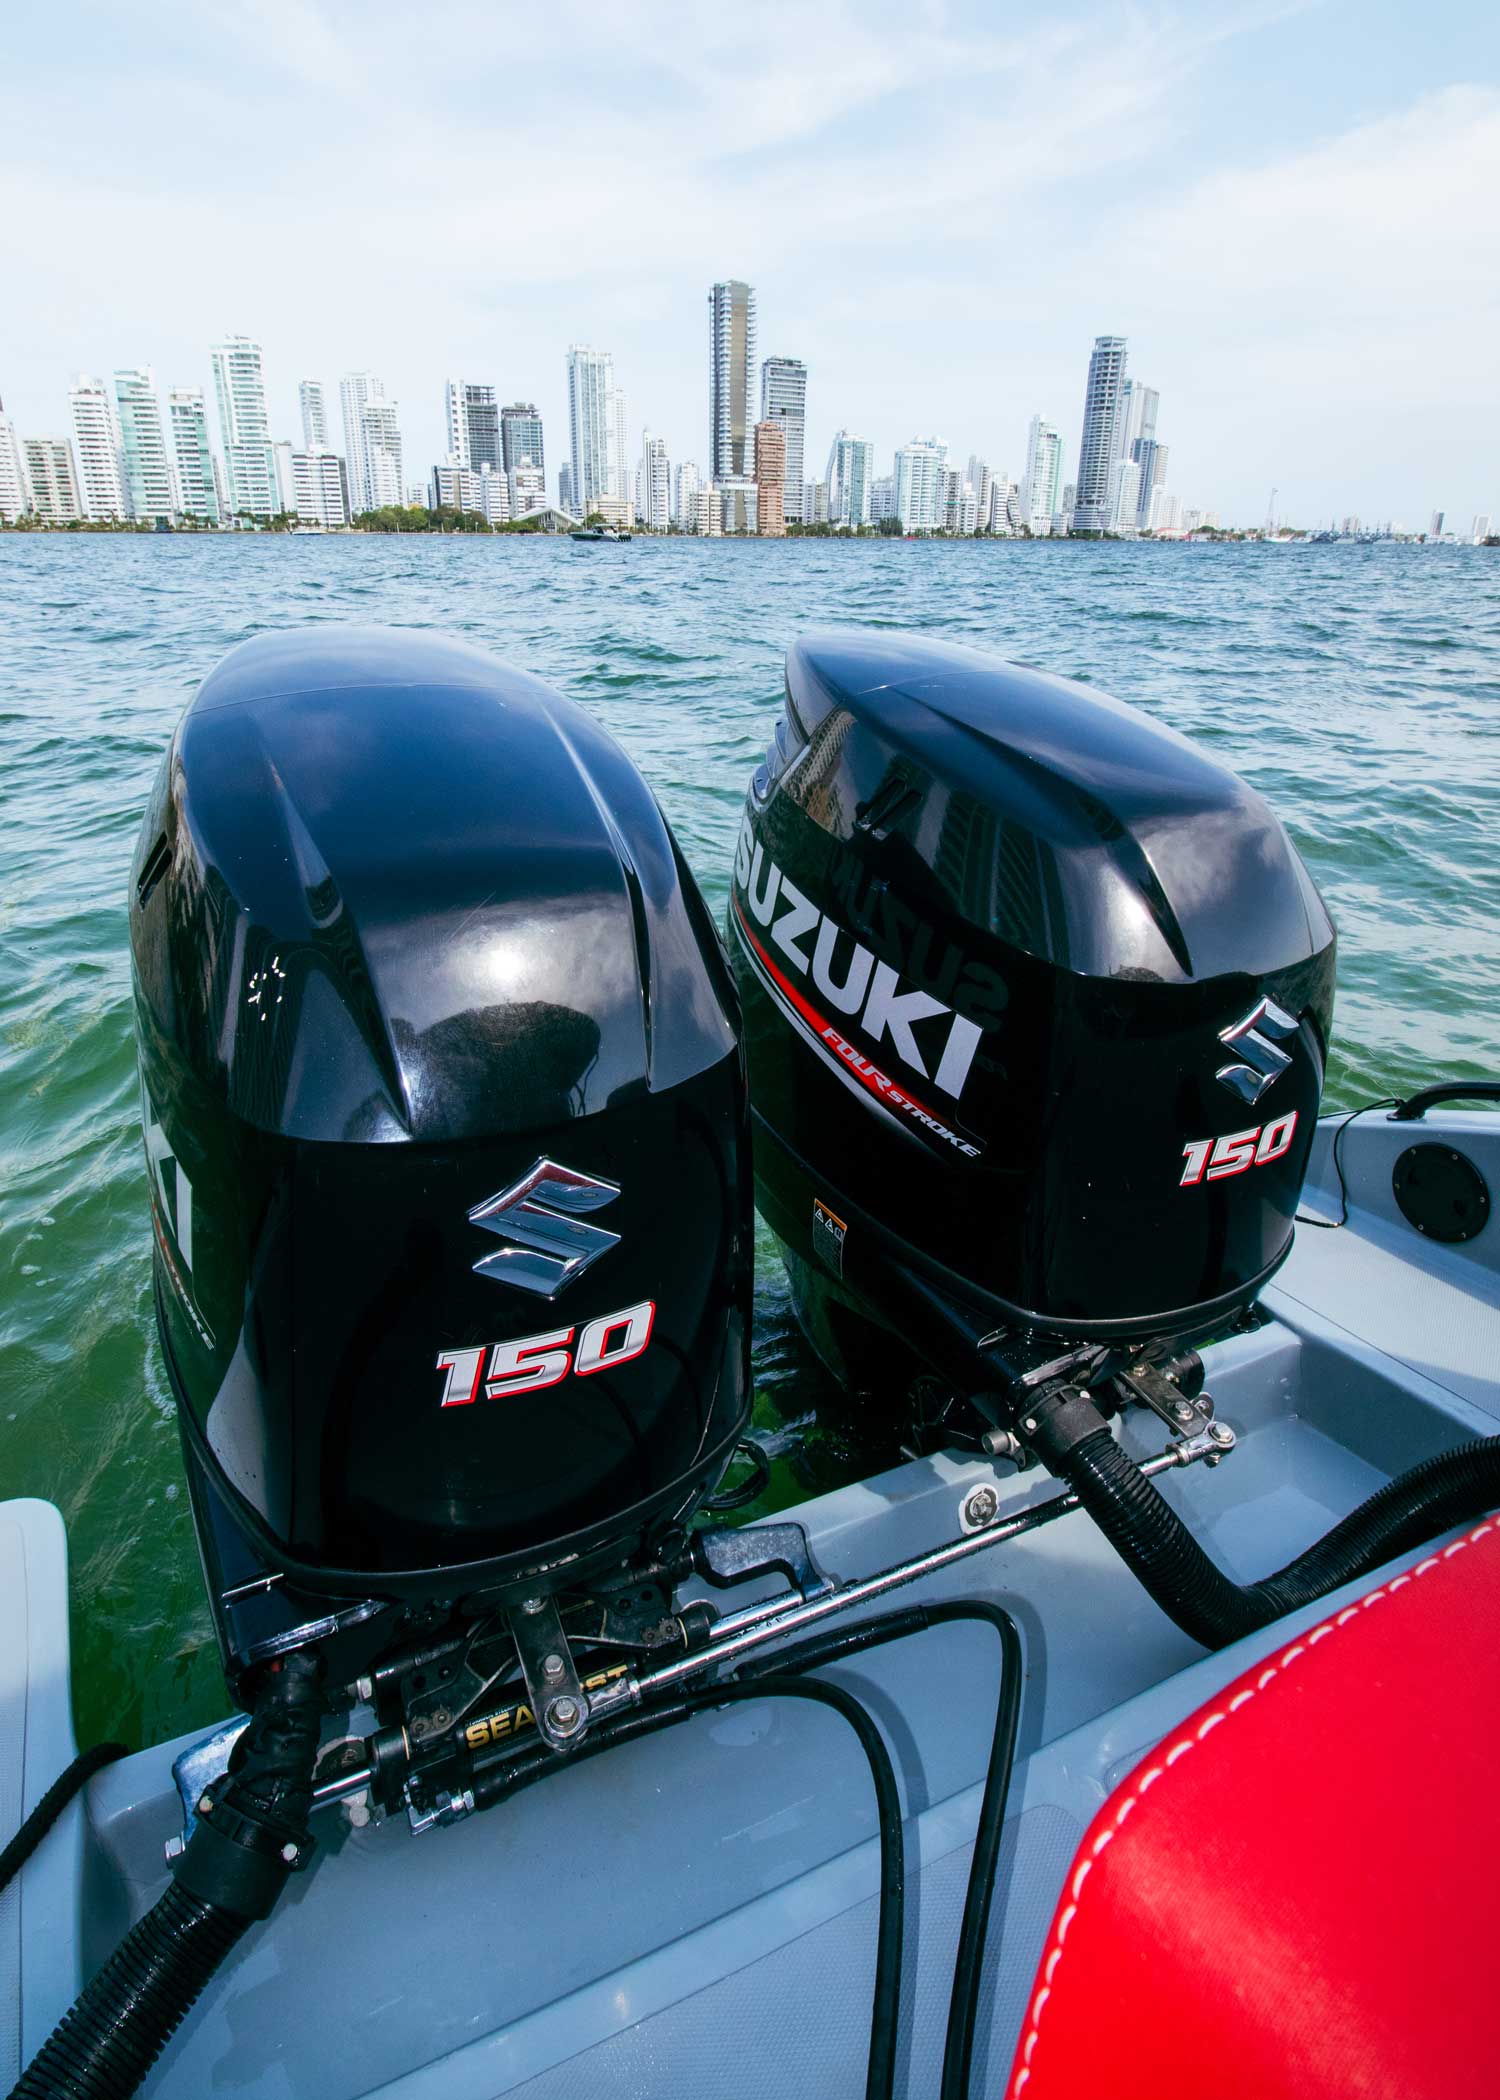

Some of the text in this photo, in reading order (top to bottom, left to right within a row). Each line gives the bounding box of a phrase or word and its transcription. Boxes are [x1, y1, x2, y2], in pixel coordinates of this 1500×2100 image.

[736, 815, 984, 1100] SUZUKI
[822, 1027, 892, 1092] FOUR
[886, 1090, 982, 1157] STROKE
[1179, 1110, 1300, 1187] 150
[435, 1299, 657, 1407] 150
